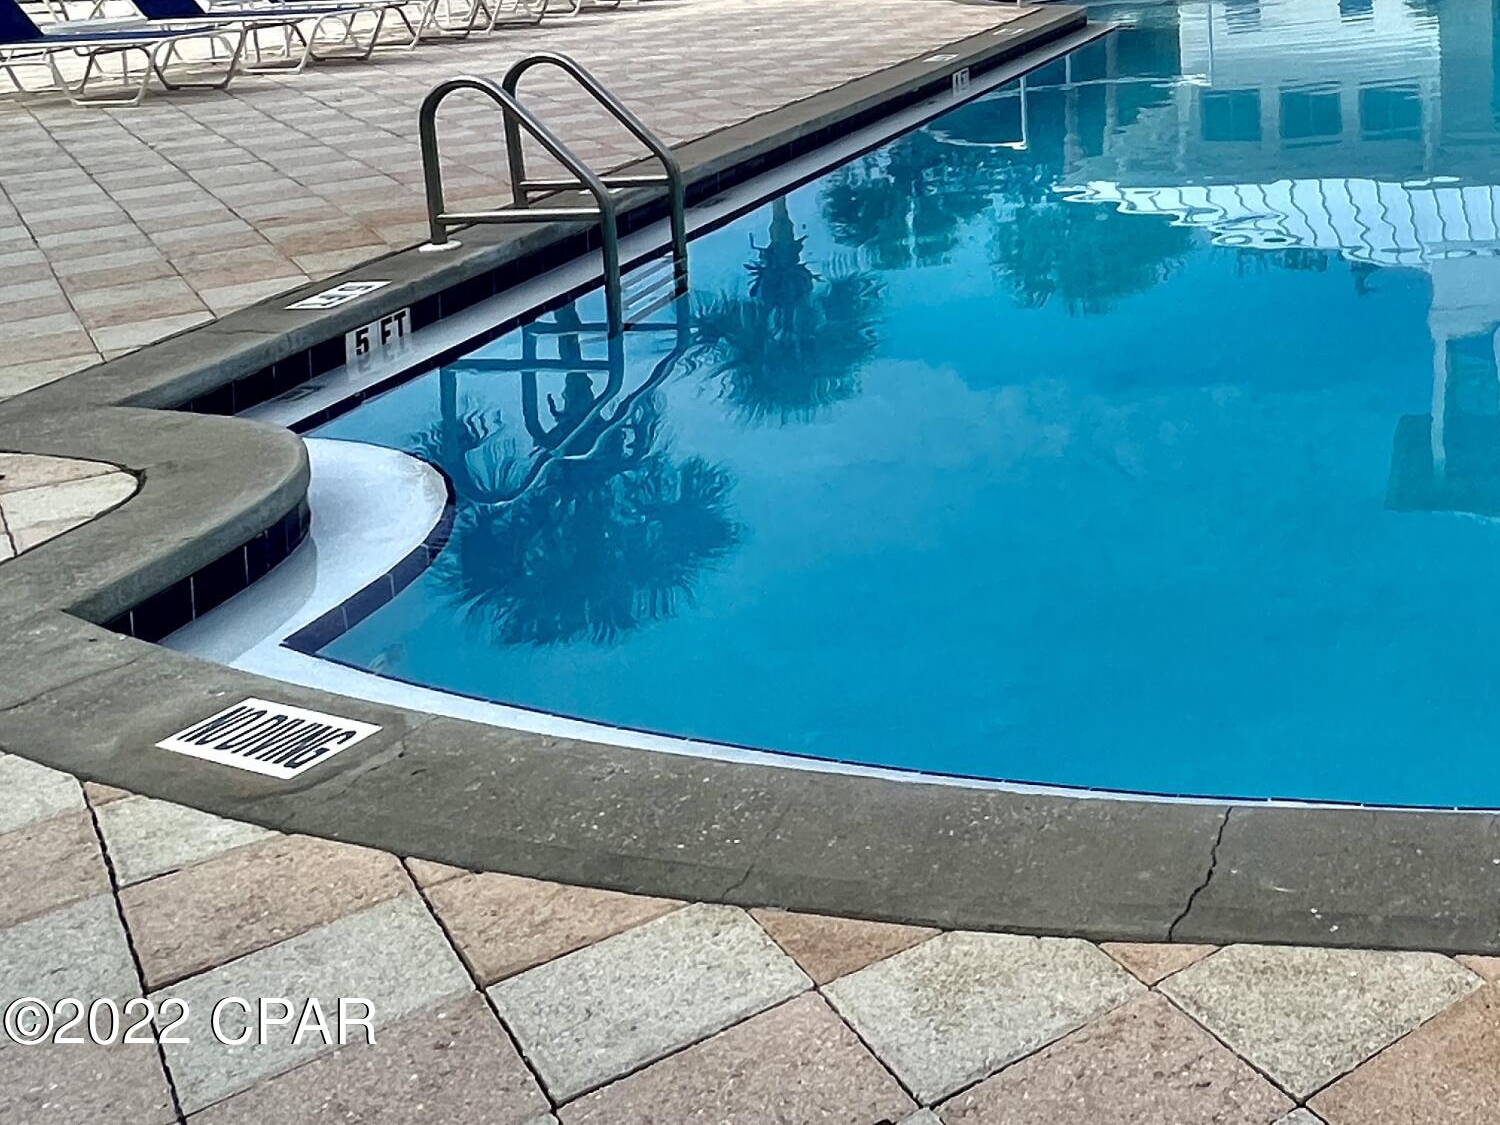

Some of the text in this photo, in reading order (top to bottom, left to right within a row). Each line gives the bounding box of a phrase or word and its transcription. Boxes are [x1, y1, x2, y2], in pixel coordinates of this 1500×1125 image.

[355, 309, 407, 356] 5 FT
[176, 705, 357, 770] NO DIVING
